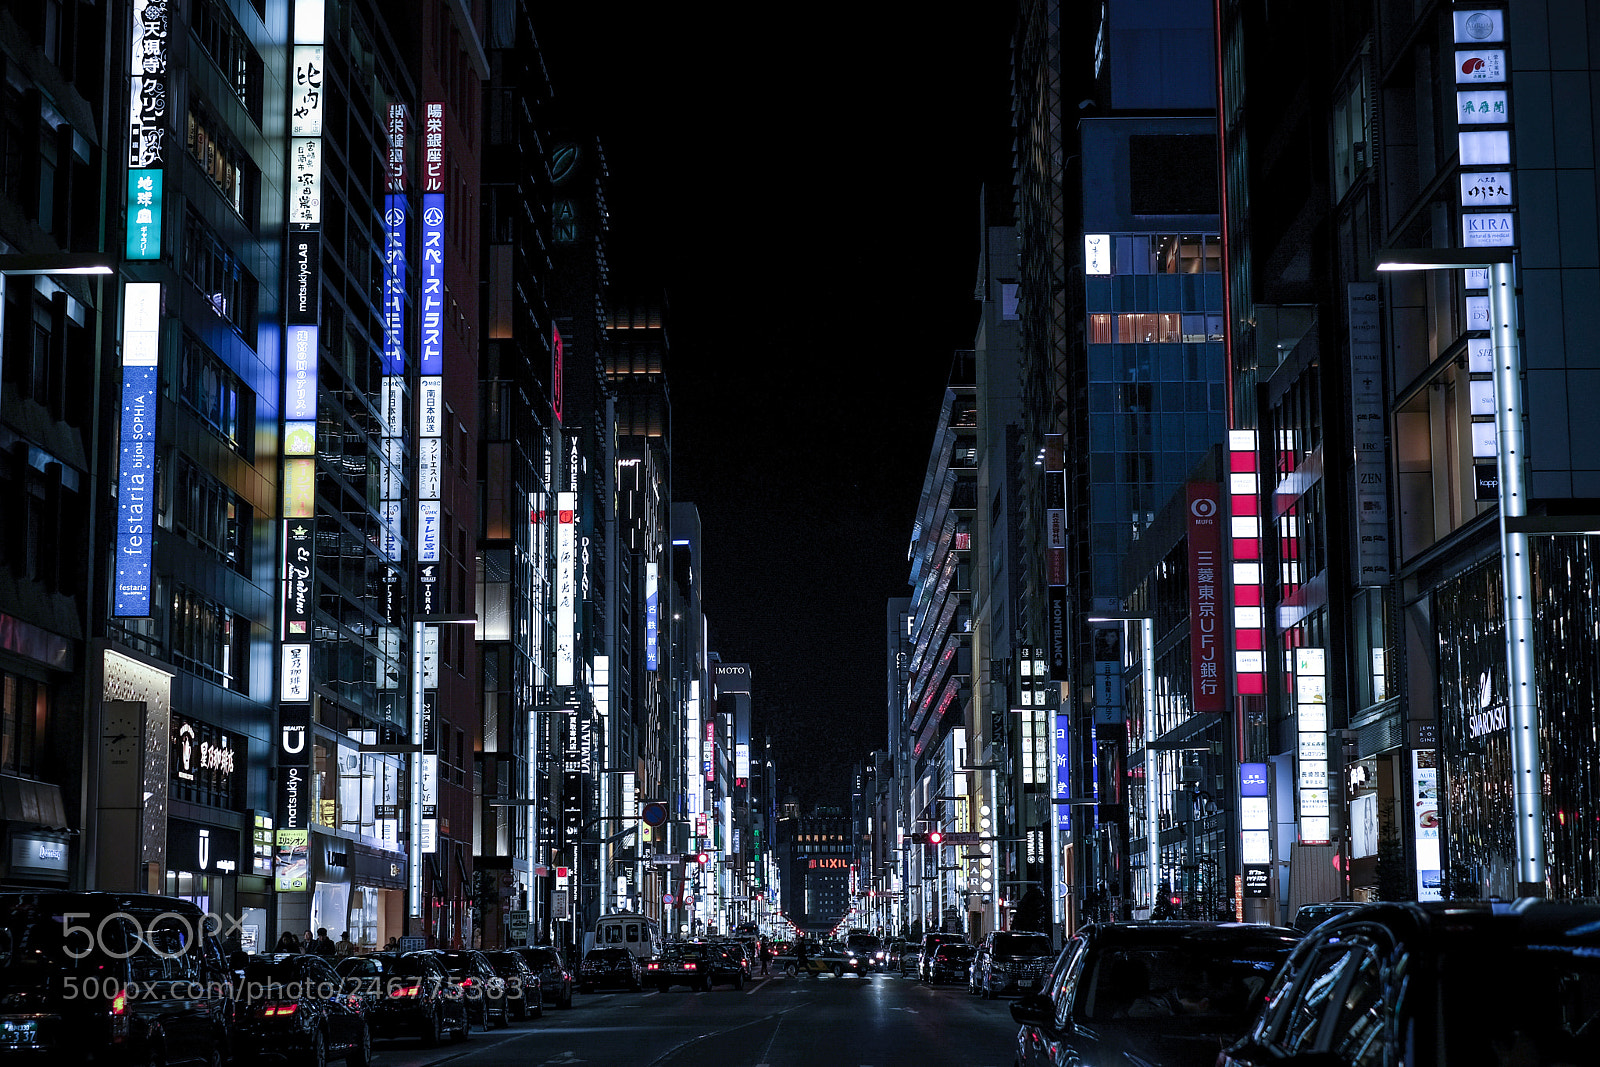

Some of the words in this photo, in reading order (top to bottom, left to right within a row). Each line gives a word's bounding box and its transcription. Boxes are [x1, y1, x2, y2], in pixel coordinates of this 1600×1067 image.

[425, 104, 441, 191] 陽栄銀座ビル
[1468, 185, 1509, 200] ゆうき丸
[1469, 218, 1509, 230] KIRA
[299, 243, 312, 312] matsukiyoLAB
[423, 231, 442, 361] スペーストラスト
[295, 331, 307, 410] 迷宮の国のアリス
[133, 395, 145, 440] SOPHIA
[425, 390, 435, 433] 南日本放送
[132, 441, 143, 468] bijou
[1361, 473, 1382, 484] ZEN
[123, 474, 144, 556] festaria
[647, 606, 656, 662] 名鉄観光
[1053, 600, 1063, 659] MONTBLANC
[1197, 551, 1218, 695] 三菱東京UFJ銀行
[289, 648, 301, 697] 星乃珈琲店
[282, 731, 304, 754] U
[581, 719, 590, 774] DAMIANI
[1469, 705, 1507, 739] SWAROVSKI
[287, 769, 302, 828] matsukiyo
[819, 858, 848, 869] LIXIL
[1027, 831, 1035, 856] YAMAHA
